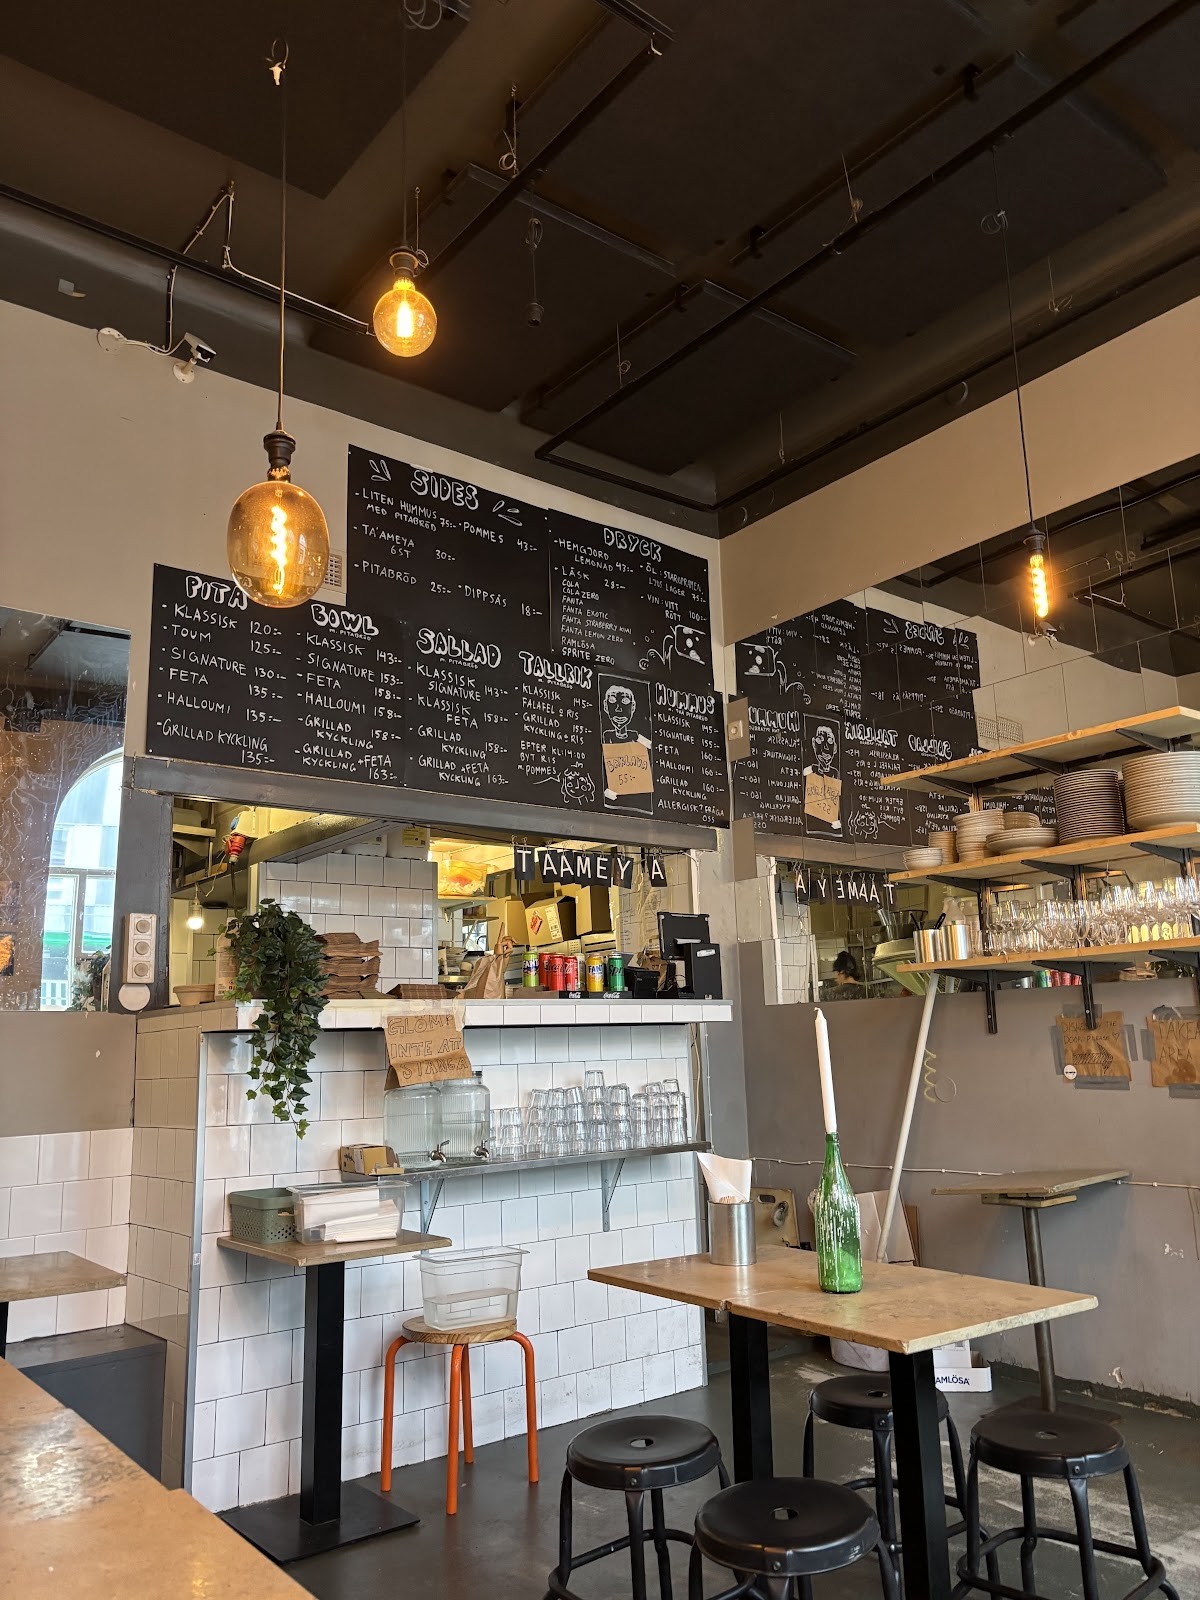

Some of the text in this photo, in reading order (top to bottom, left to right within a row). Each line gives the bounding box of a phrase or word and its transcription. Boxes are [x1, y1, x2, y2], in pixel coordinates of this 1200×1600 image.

[410, 469, 479, 510] SIDES
[362, 488, 394, 506] LITEN
[400, 500, 437, 520] HUMMUS
[366, 503, 387, 516] MED
[464, 521, 504, 544] POMMES
[604, 528, 662, 562] DRYCK
[574, 554, 614, 572] LEMONAD
[562, 579, 580, 588] COLA
[665, 583, 685, 597] LAGER
[185, 576, 248, 610] PITA
[562, 587, 600, 600] COLA ZERO
[562, 595, 584, 605] FANTA
[562, 605, 609, 620] FANTA EXOTIC
[665, 600, 678, 611] VITT
[174, 603, 238, 629] KLASSISK
[310, 604, 380, 636] BOWL
[562, 614, 582, 625] FANTA
[172, 624, 211, 642] TOUM
[561, 624, 582, 636] FANTA
[607, 634, 624, 643] ZERO
[306, 632, 365, 656] KLASSISK
[416, 628, 502, 669] SALLAD
[171, 647, 247, 676] SIGNATURE
[562, 647, 615, 665] SPRITE ZERO
[169, 668, 209, 685] FETA
[307, 653, 375, 683] SIGNATURE
[416, 662, 476, 688] KLASSISK
[518, 650, 593, 690] TALLRIK
[306, 672, 342, 689] FETA
[428, 680, 481, 702] SIGNATURE
[522, 682, 561, 700] KLASSISK
[167, 691, 231, 714] HALLOUMI
[305, 692, 366, 715] HALLOUMI
[417, 694, 472, 716] KLASSISK
[522, 697, 555, 714] FALAFEL
[566, 709, 579, 720] RIS
[305, 714, 352, 733] GRILLAD
[446, 714, 479, 729] FETA
[522, 712, 560, 728] GRILLAD
[657, 712, 690, 728] KLASSISK
[162, 718, 268, 752] GRILLAD KYCKLING
[316, 730, 374, 750] KYCKLING
[418, 725, 462, 742] GRILLAD
[524, 724, 562, 740] KYCKLING
[570, 734, 584, 745] RIS
[659, 728, 694, 745] SIGNATURE
[302, 743, 353, 760] GRILLAD
[441, 744, 487, 760] KYCKLING
[520, 740, 547, 752] EFTER
[658, 744, 679, 756] FETA
[302, 756, 357, 772] KYCKLING
[418, 754, 456, 771] GRILLAD
[520, 752, 556, 764] BYT RIS
[660, 759, 694, 774] HALLOUMI
[526, 764, 557, 776] POMMES
[438, 772, 481, 787] KYCKLING
[660, 775, 688, 787] GRILLAD
[673, 787, 707, 800] KYCKLING
[702, 815, 715, 824] OSS
[390, 1040, 432, 1059] INTE
[935, 1373, 970, 1386] AMLÖSA
